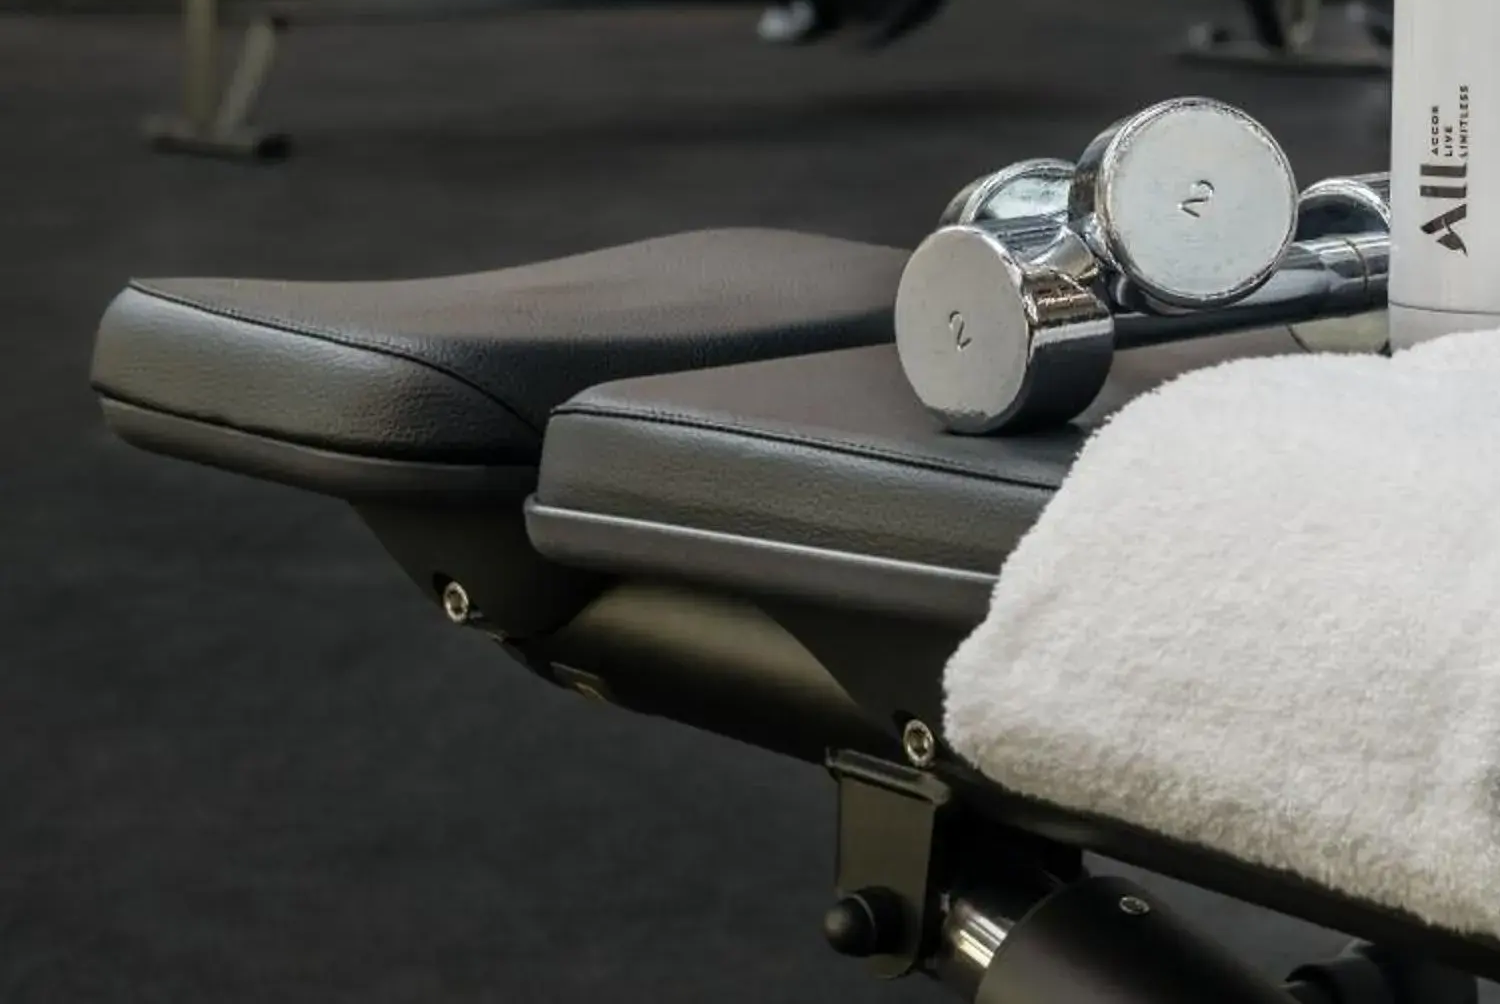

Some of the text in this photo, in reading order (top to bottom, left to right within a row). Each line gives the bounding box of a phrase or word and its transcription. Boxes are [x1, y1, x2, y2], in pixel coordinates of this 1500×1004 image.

[1431, 105, 1440, 157] ACCOR
[1444, 125, 1453, 157] LIVE
[1459, 85, 1469, 158] LIMITLESS
[1177, 179, 1215, 219] 2
[1420, 164, 1468, 257] ALL
[949, 310, 973, 352] 2
